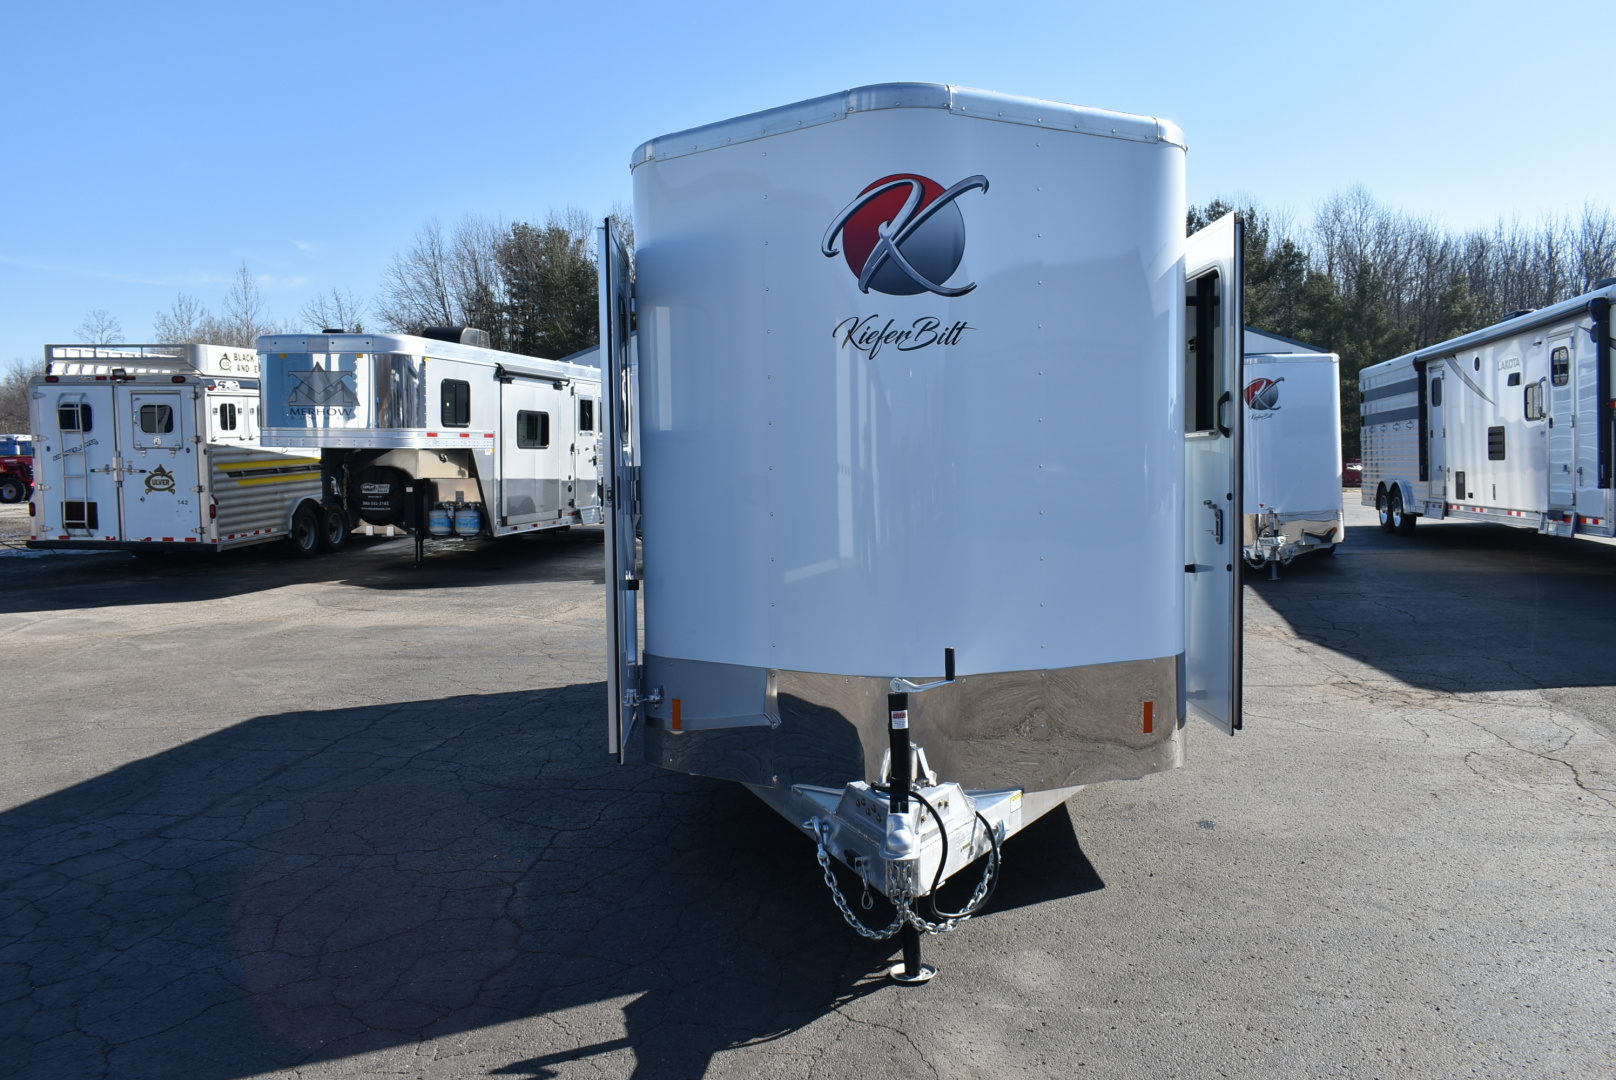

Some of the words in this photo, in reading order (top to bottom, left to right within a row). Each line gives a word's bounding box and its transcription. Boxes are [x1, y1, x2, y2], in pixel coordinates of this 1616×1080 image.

[233, 352, 255, 363] BLACK
[236, 363, 250, 373] AND
[1497, 357, 1521, 372] LAKOTA
[289, 407, 353, 416] MERHOW
